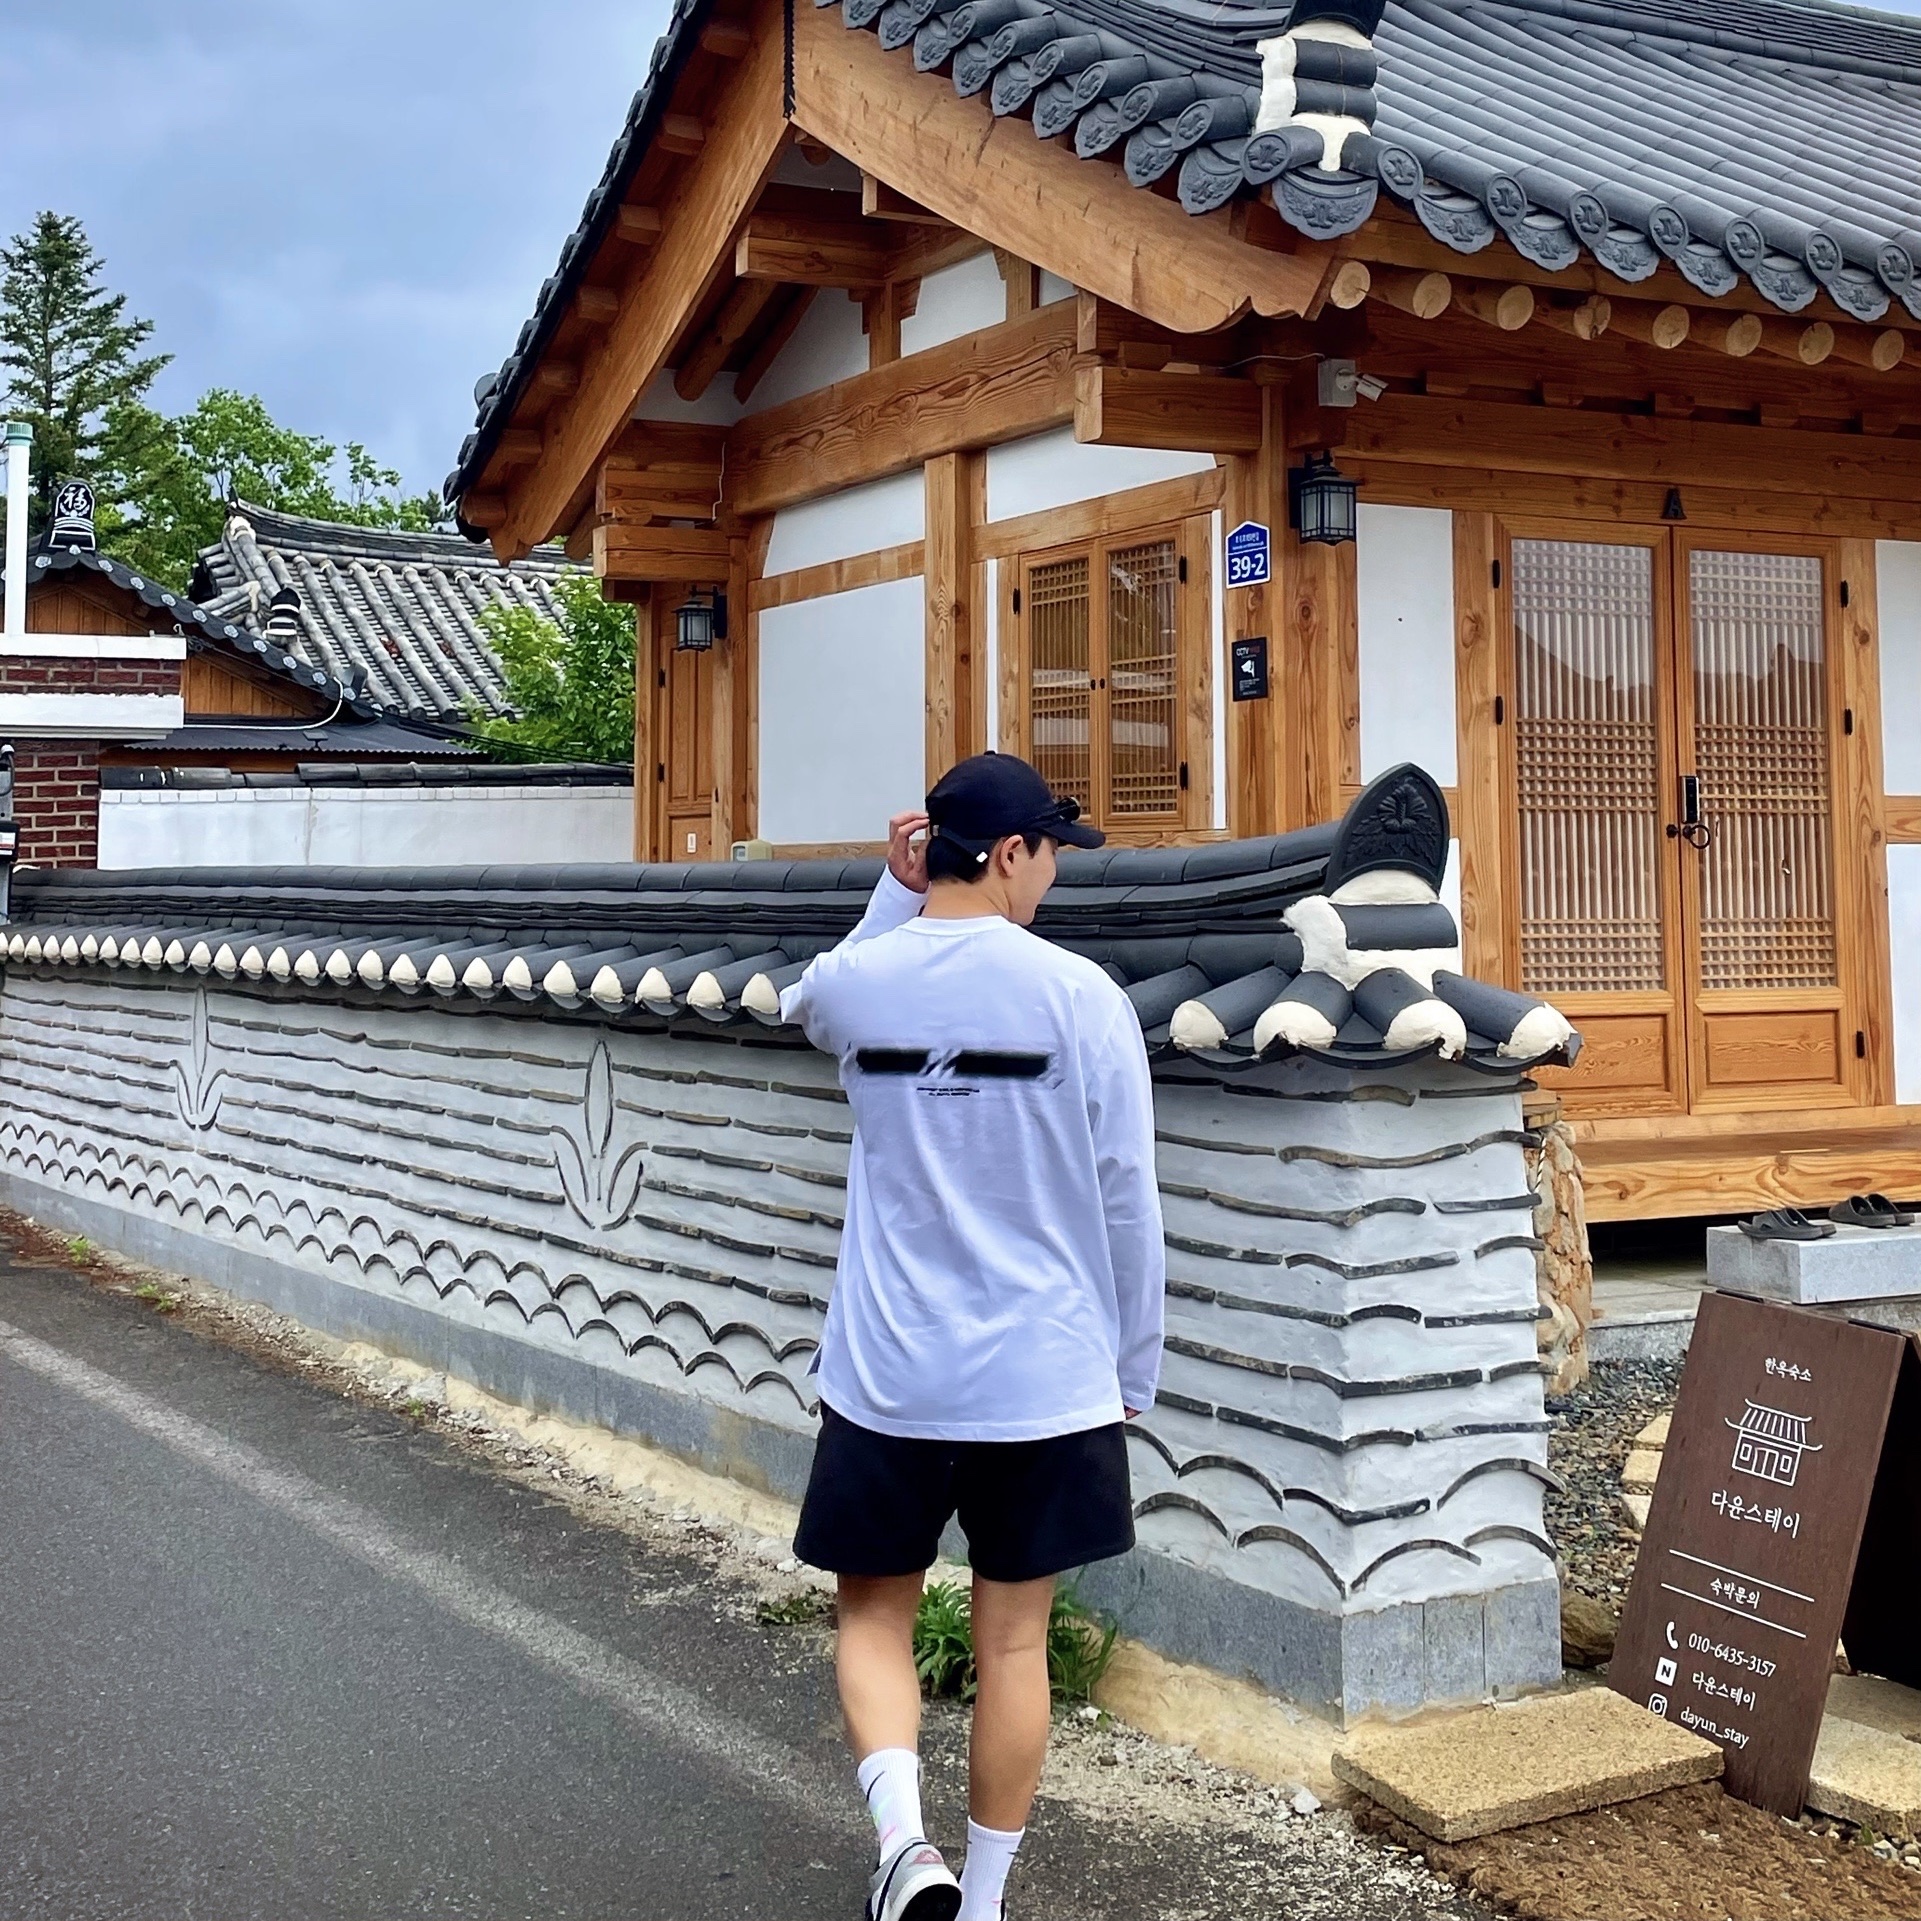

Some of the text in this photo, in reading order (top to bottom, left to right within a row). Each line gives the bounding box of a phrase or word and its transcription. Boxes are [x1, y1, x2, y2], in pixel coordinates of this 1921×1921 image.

[1231, 553, 1266, 580] 39-2
[1764, 1357, 1812, 1382] 한옥숙소
[1711, 1489, 1800, 1539] 다윤스테이
[1710, 1578, 1760, 1609] 숙박문의
[1688, 1632, 1776, 1678] 010-6435-3157
[1692, 1671, 1756, 1711] 다윤스테이
[1680, 1706, 1749, 1749] dayun_stay
